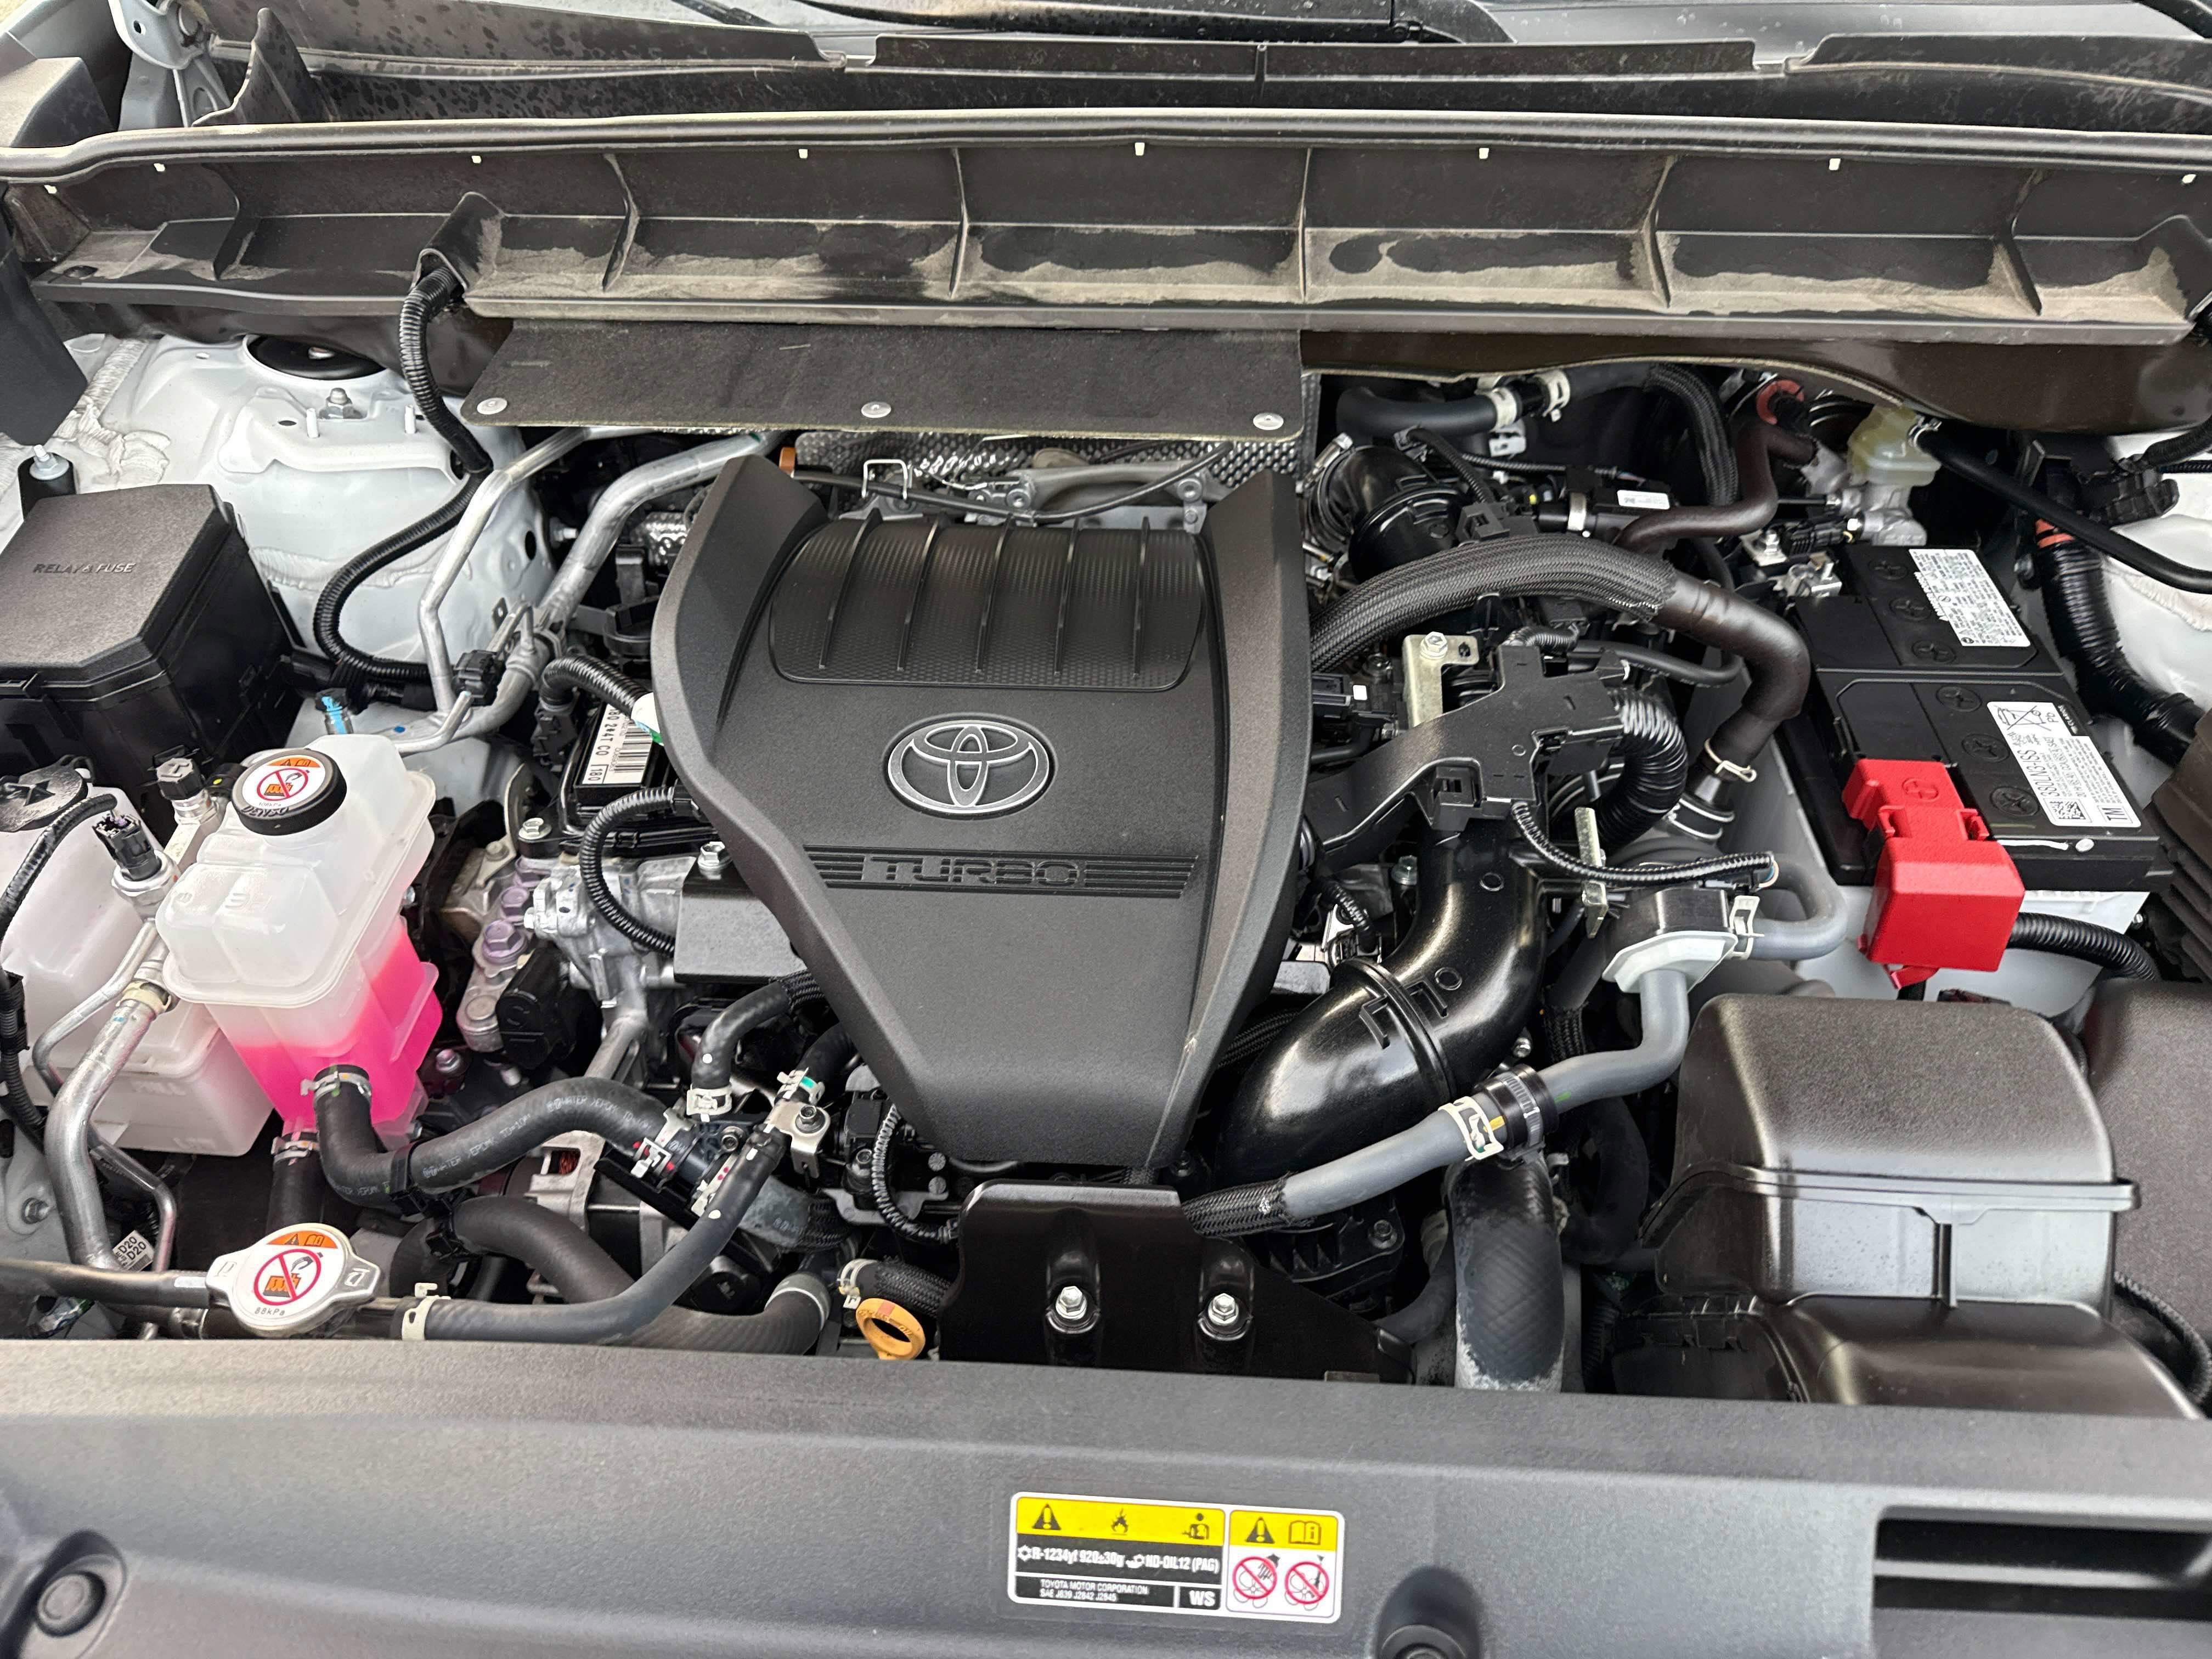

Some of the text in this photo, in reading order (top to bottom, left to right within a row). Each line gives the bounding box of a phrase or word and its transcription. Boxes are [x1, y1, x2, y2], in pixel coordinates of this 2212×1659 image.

[33, 562, 136, 573] RELAY & FUSE
[2045, 712, 2058, 723] Pb
[588, 769, 603, 781] 180
[2017, 749, 2060, 797] 380LN3-ISS
[241, 805, 290, 817] DENSO
[2101, 808, 2128, 821] TM
[868, 856, 1081, 887] TURBO
[118, 1237, 137, 1254] D20
[127, 1242, 146, 1260] D20
[255, 1307, 285, 1317] 88kPa
[1032, 1547, 1078, 1564] R-1234yf
[1192, 1557, 1220, 1574] (PAG)
[1040, 1579, 1149, 1595] TOYOTA MOTOR CORPORATION
[1040, 1588, 1054, 1598] SAE
[1189, 1590, 1216, 1607] WS
